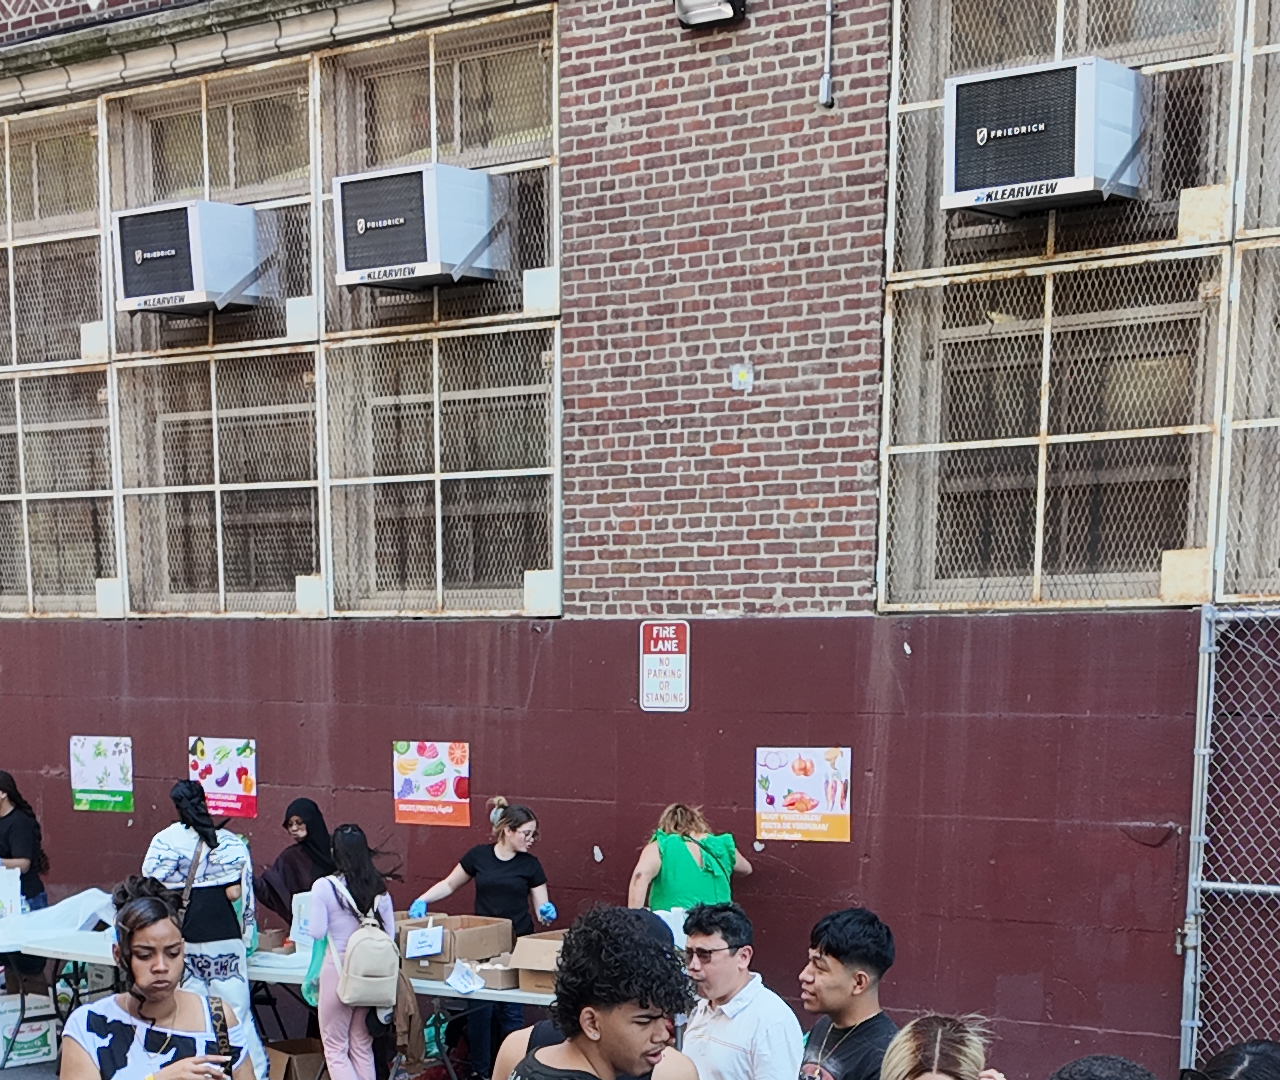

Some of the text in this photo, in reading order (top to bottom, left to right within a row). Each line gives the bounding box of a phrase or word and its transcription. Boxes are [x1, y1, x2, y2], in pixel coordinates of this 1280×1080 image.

[990, 122, 1045, 139] FRIEDRICH
[985, 182, 1058, 202] KLEARVIEW
[367, 217, 405, 229] FRIEDRICH
[367, 266, 416, 280] KLEARVIEW
[652, 626, 677, 638] FIRE
[650, 639, 679, 652] LANE
[658, 656, 670, 667] NO
[647, 668, 682, 679] PARKING
[658, 680, 670, 691] OR
[645, 692, 684, 703] STANDING
